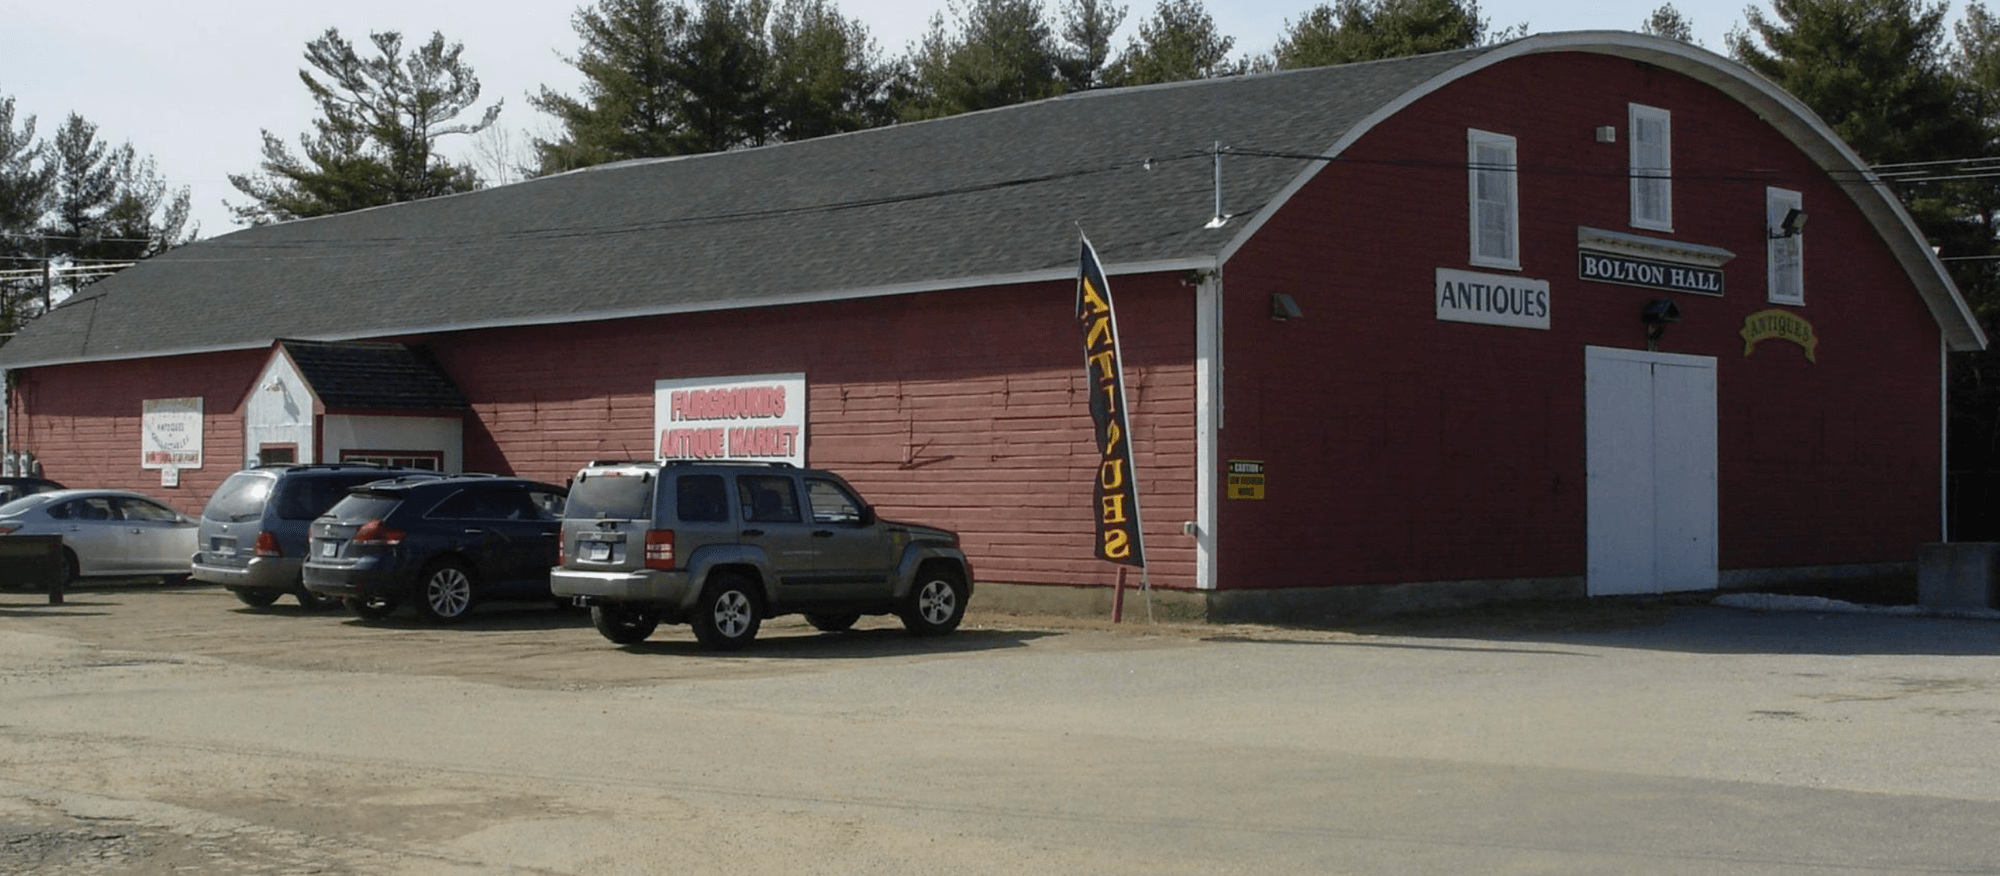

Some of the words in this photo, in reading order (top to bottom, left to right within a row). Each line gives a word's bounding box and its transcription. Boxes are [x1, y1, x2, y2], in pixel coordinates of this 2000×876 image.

[1584, 256, 1664, 284] BOLTON
[1670, 268, 1720, 291] HALL
[1440, 281, 1547, 318] ANTIQUES
[1749, 315, 1812, 342] ANTIQUES
[670, 384, 786, 421] FAIRGROUNDS
[659, 427, 725, 459] ANTIQUE
[728, 424, 799, 458] MARKET
